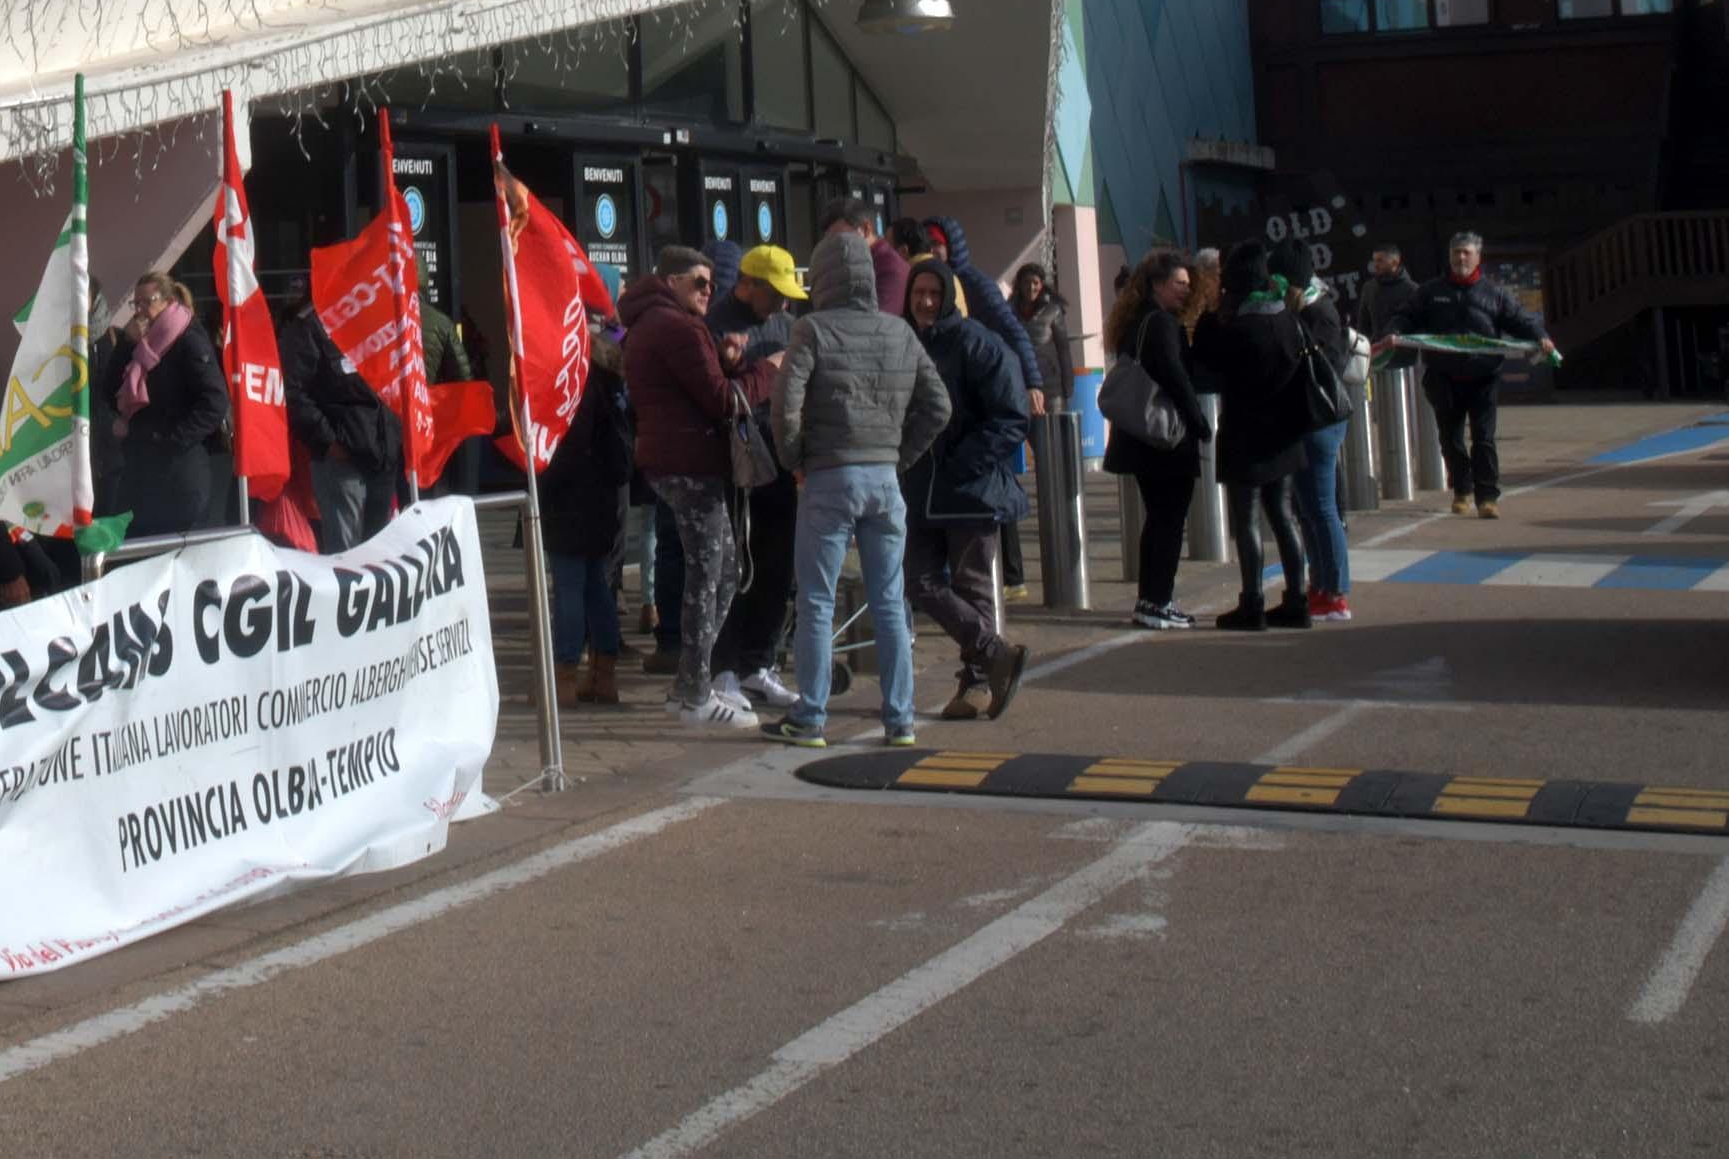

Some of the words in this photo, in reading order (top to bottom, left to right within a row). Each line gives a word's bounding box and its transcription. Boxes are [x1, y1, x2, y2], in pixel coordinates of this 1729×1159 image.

[392, 158, 433, 175] ENVENUTI
[583, 166, 624, 183] BENVENUTI
[1265, 208, 1333, 242] OLD
[193, 569, 317, 665] CGIL
[153, 694, 250, 759] LAVORATORI
[256, 671, 347, 731] COMMERCIO
[117, 780, 248, 872] PROVINCIA
